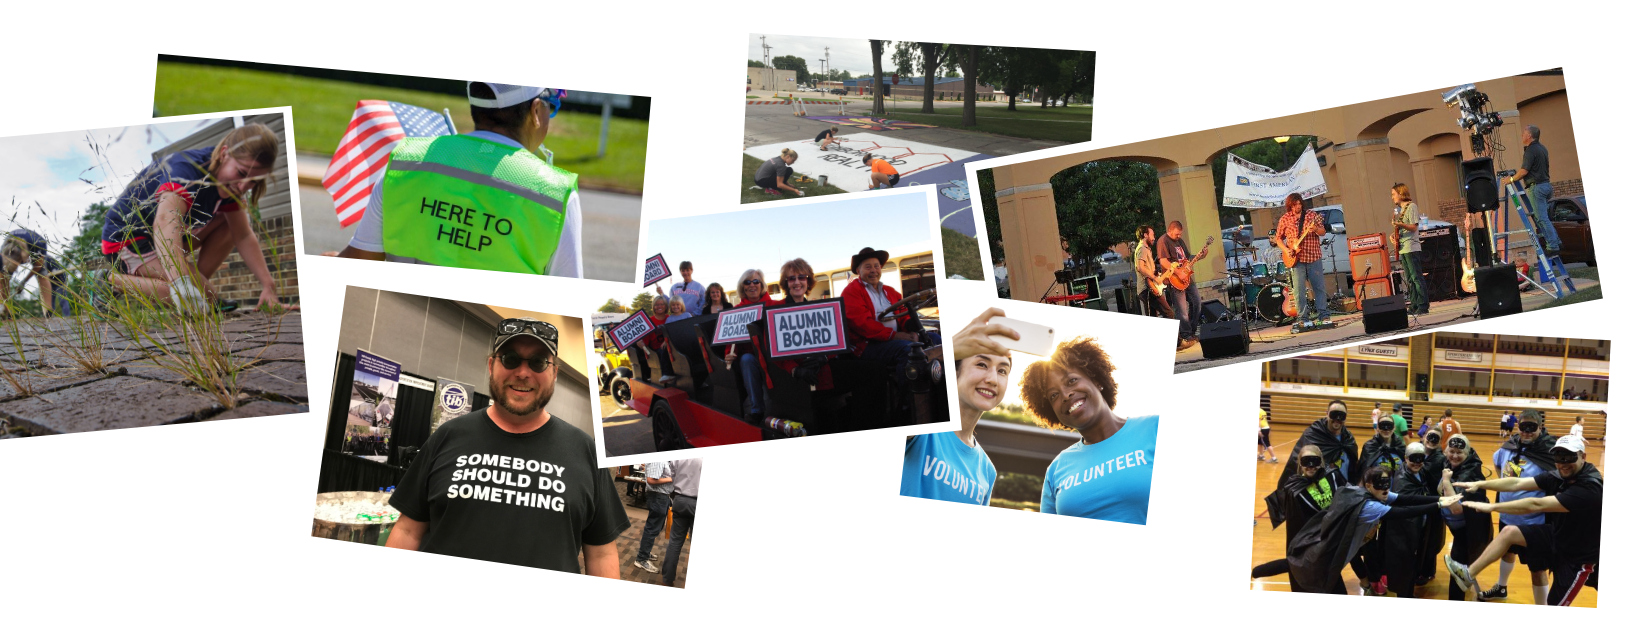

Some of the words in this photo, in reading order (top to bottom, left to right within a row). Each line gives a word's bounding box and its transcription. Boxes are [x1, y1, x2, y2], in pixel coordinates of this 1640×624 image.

[420, 197, 477, 227] HERE
[483, 212, 513, 236] TO
[437, 224, 493, 251] HELP
[644, 268, 662, 282] OARD
[645, 260, 660, 273] UMNI
[617, 317, 644, 337] ALUMNI
[723, 311, 756, 326] ALUMNI
[779, 310, 832, 332] ALUMNI
[622, 325, 647, 343] BOARD
[783, 327, 832, 348] BOARD
[446, 394, 464, 406] tib
[1446, 423, 1453, 433] 5
[455, 453, 566, 478] SOMEBODY
[451, 468, 531, 488] SHOULD
[538, 476, 567, 494] DO
[922, 454, 987, 505] VOLUNTE
[446, 484, 566, 513] SOMETHING
